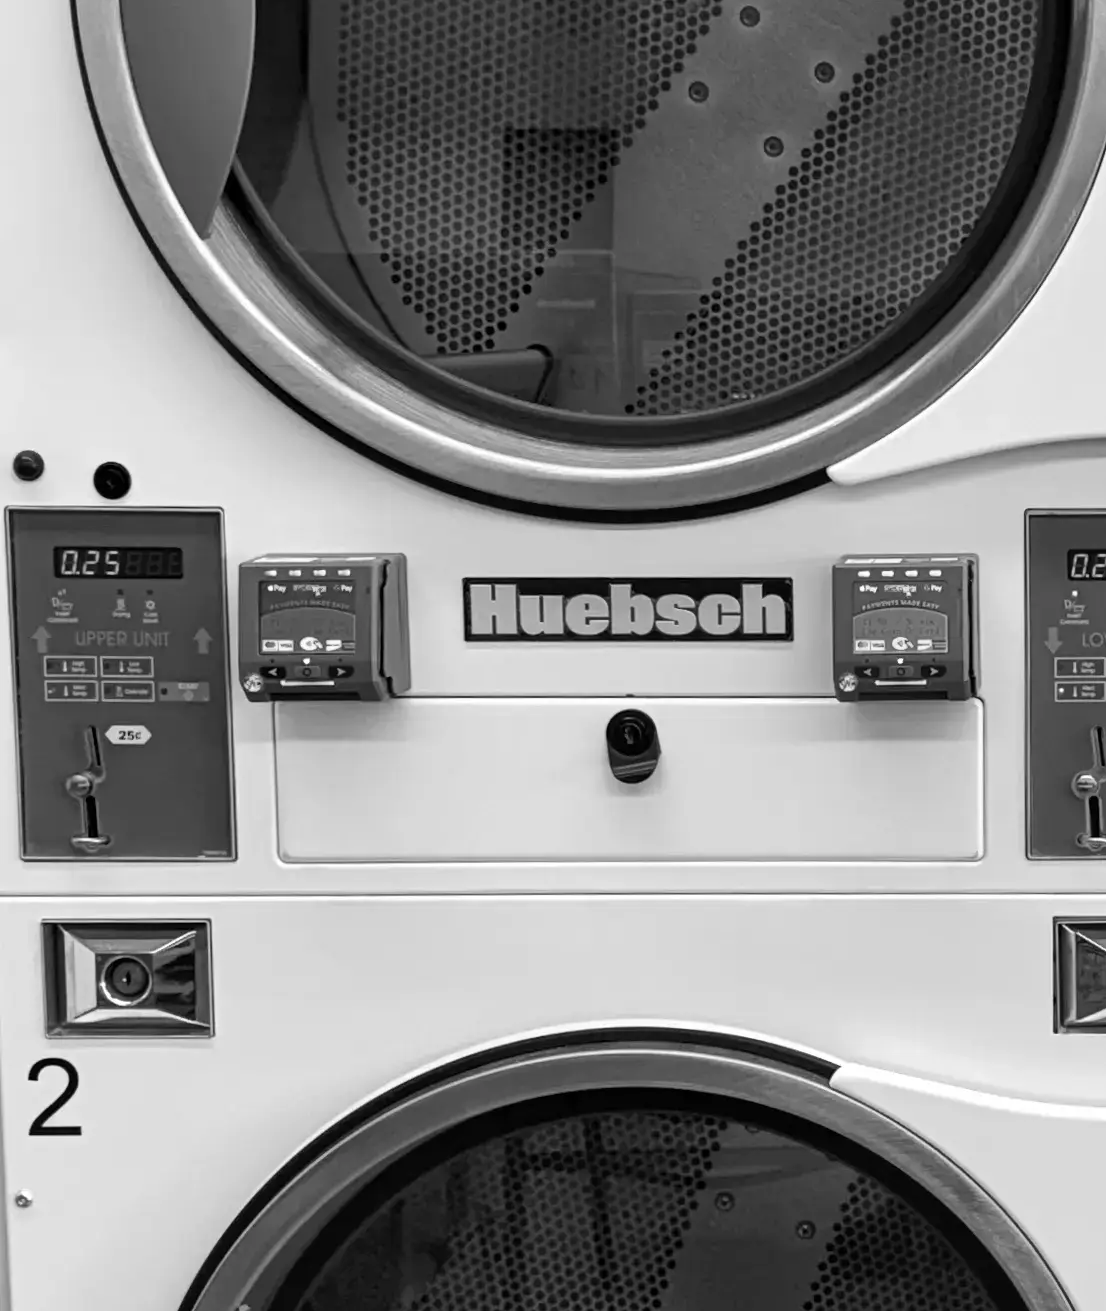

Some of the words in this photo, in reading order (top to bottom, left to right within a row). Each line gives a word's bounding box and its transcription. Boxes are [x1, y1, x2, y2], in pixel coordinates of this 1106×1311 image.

[61, 550, 120, 575] 0.25
[469, 584, 787, 636] Huebsch
[75, 630, 128, 647] UPPER
[133, 630, 171, 647] UNIT
[28, 1057, 82, 1136] 2
